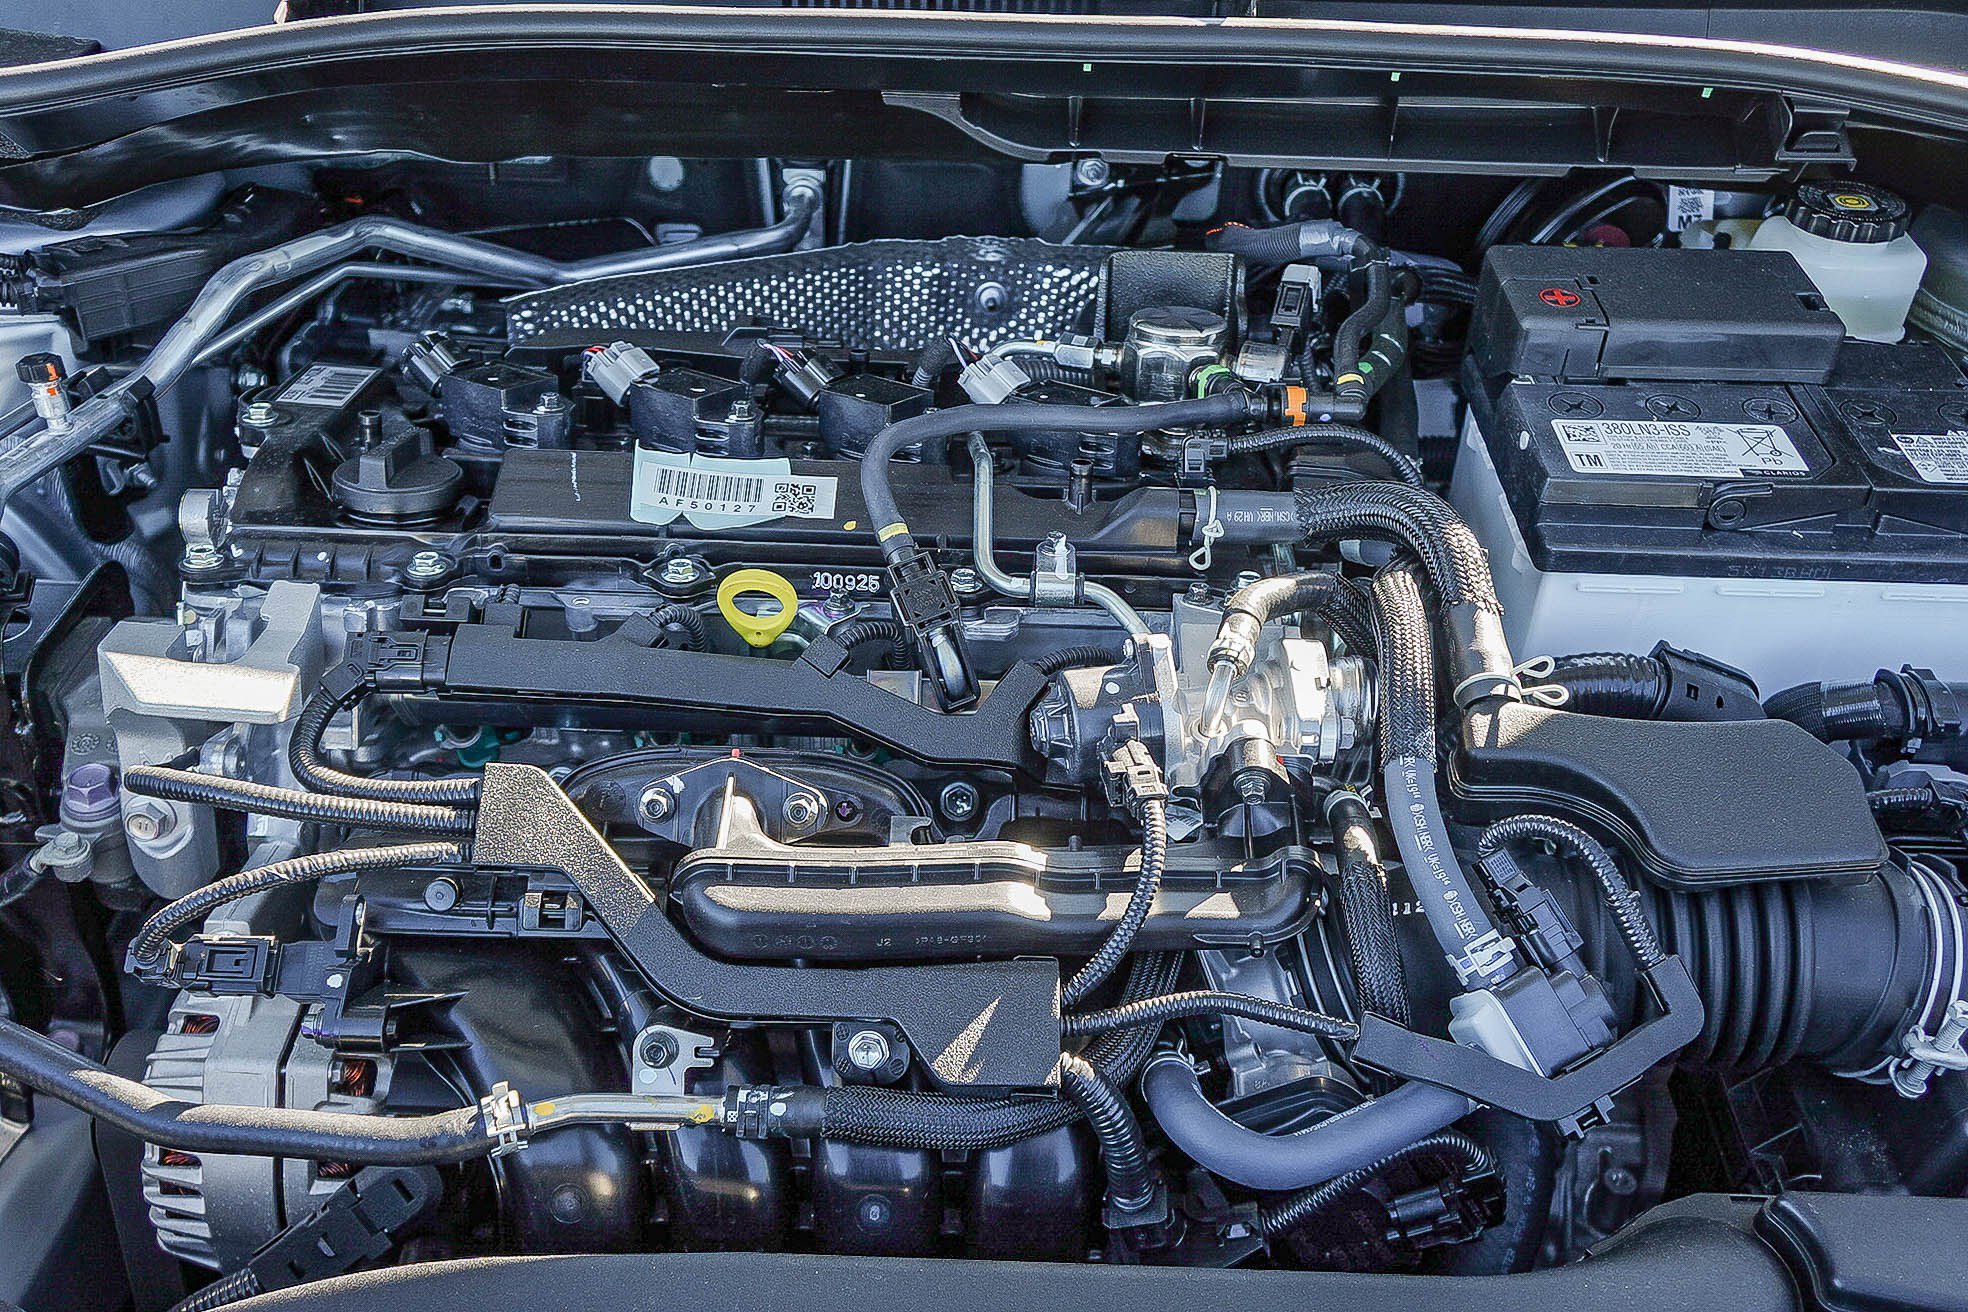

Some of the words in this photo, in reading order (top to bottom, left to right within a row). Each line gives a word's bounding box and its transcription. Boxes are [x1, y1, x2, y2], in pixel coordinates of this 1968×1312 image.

[1602, 422, 1691, 437] 380LN3-ISS
[1574, 453, 1604, 468] TM
[1760, 457, 1784, 466] Pb
[659, 496, 756, 513] AF50127
[812, 571, 880, 593] 100925
